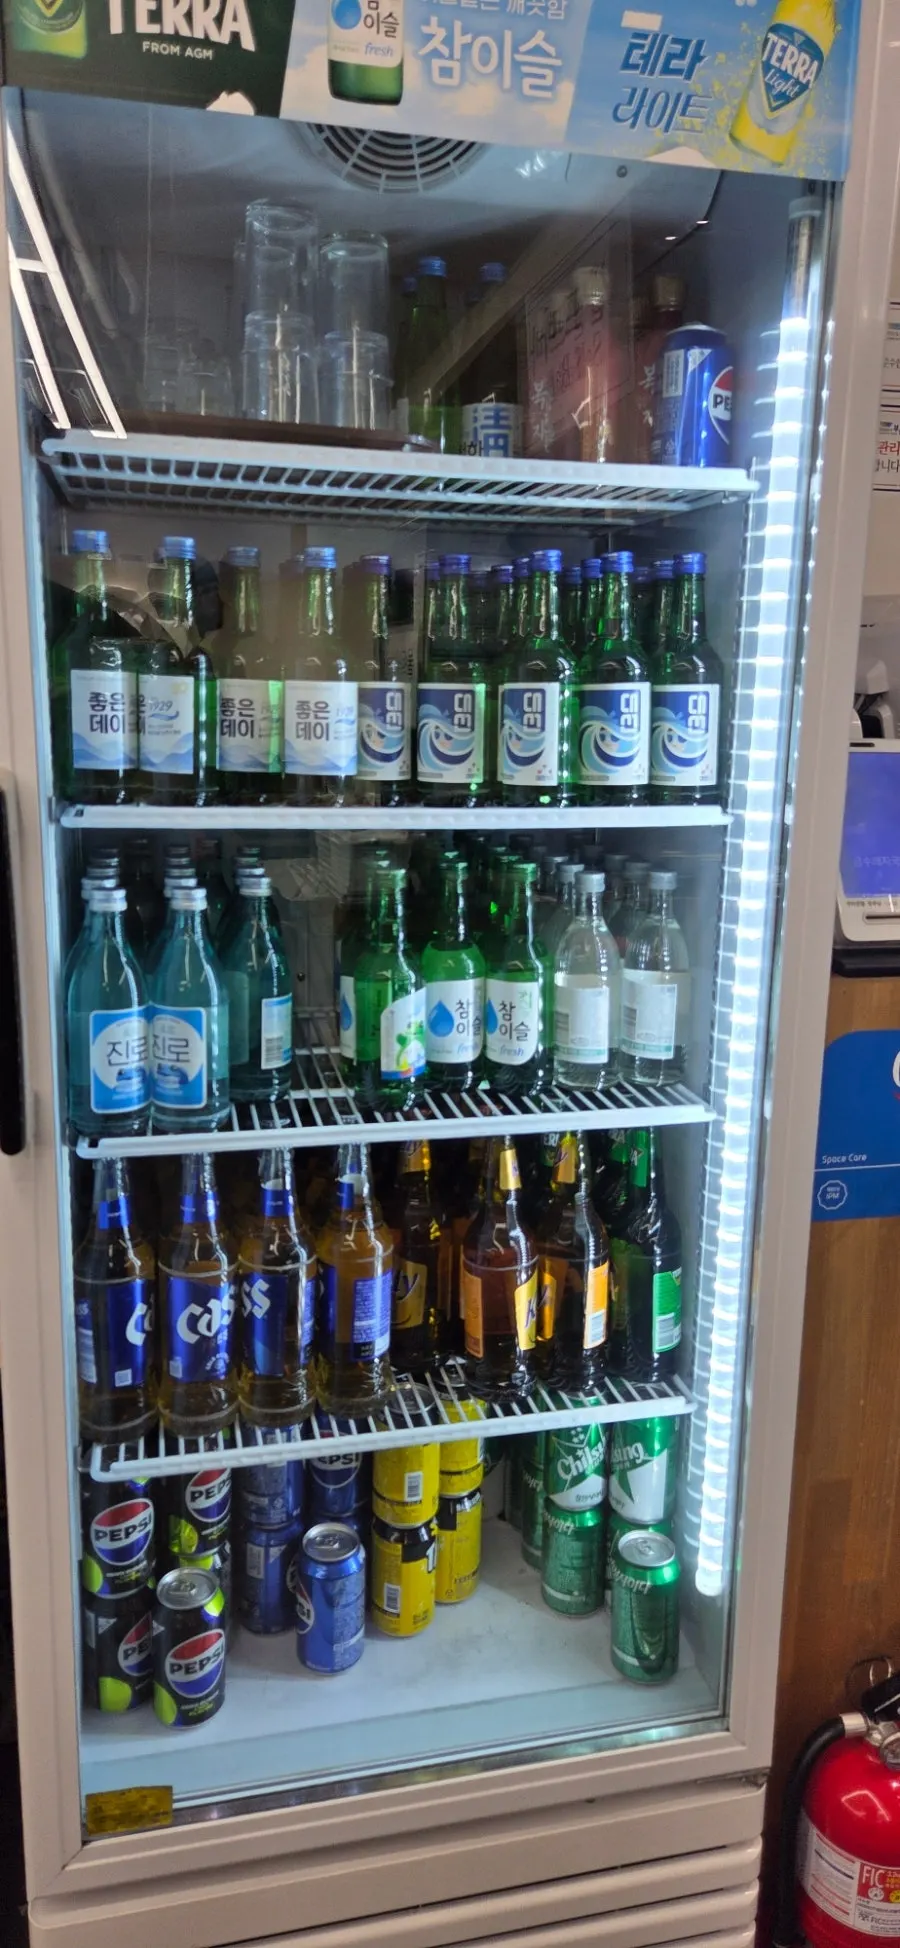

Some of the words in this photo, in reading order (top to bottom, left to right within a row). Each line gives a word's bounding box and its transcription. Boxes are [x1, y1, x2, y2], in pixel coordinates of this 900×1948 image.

[142, 41, 181, 56] FROM
[181, 47, 214, 60] AGM
[364, 42, 394, 57] fresh
[418, 15, 562, 98] 참이슬
[619, 31, 710, 84] 테라
[762, 32, 819, 90] TERRA
[764, 68, 800, 98] Light
[612, 86, 713, 135] 라이트
[88, 691, 125, 712] 좋은
[220, 697, 255, 718] 좋은
[295, 700, 331, 721] 좋은
[89, 714, 126, 735] 데이
[220, 719, 255, 739] 데이
[295, 721, 331, 741] 데이
[498, 1000, 516, 1022] 참
[499, 1021, 531, 1042] 이슬
[106, 1036, 149, 1067] 진로
[152, 1034, 191, 1063] 진로
[822, 1154, 847, 1165] Space
[848, 1152, 868, 1162] Care
[94, 1513, 152, 1543] PEPSI
[862, 1865, 886, 1889] FIC
